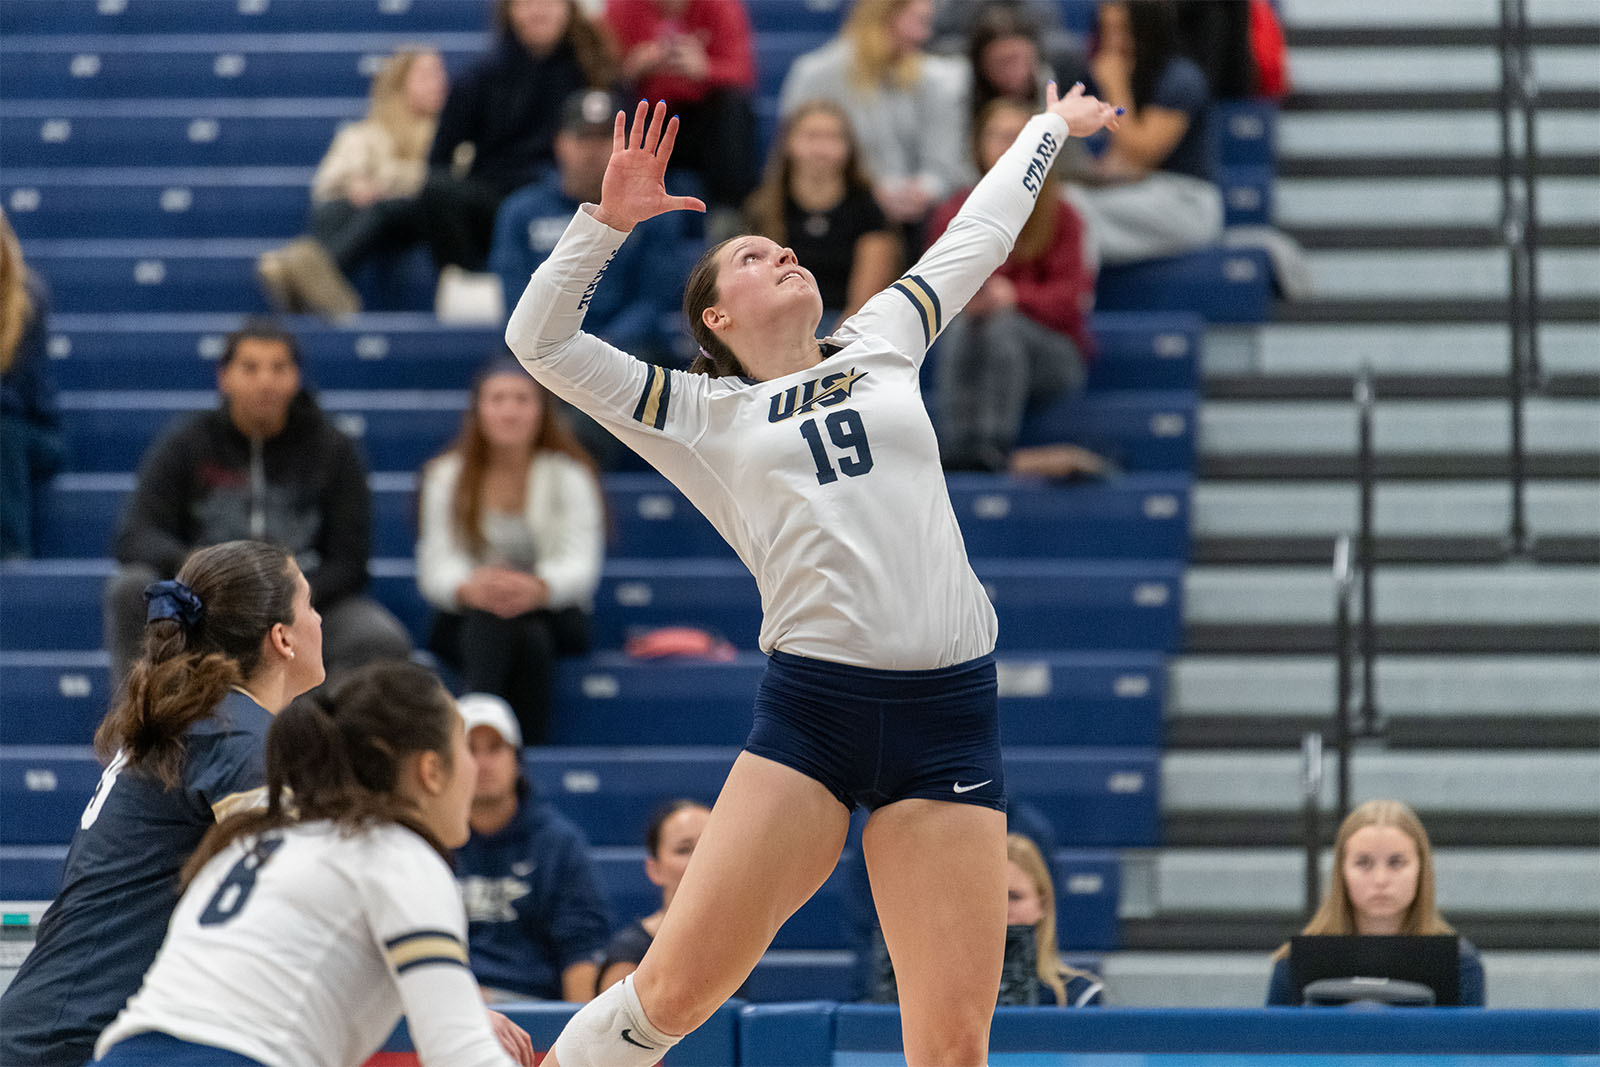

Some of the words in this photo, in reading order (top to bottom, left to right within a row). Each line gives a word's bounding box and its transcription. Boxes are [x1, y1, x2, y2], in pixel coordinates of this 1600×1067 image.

[1023, 132, 1057, 199] STARS
[768, 368, 862, 423] UIS
[799, 408, 874, 485] 19
[198, 837, 284, 926] 8
